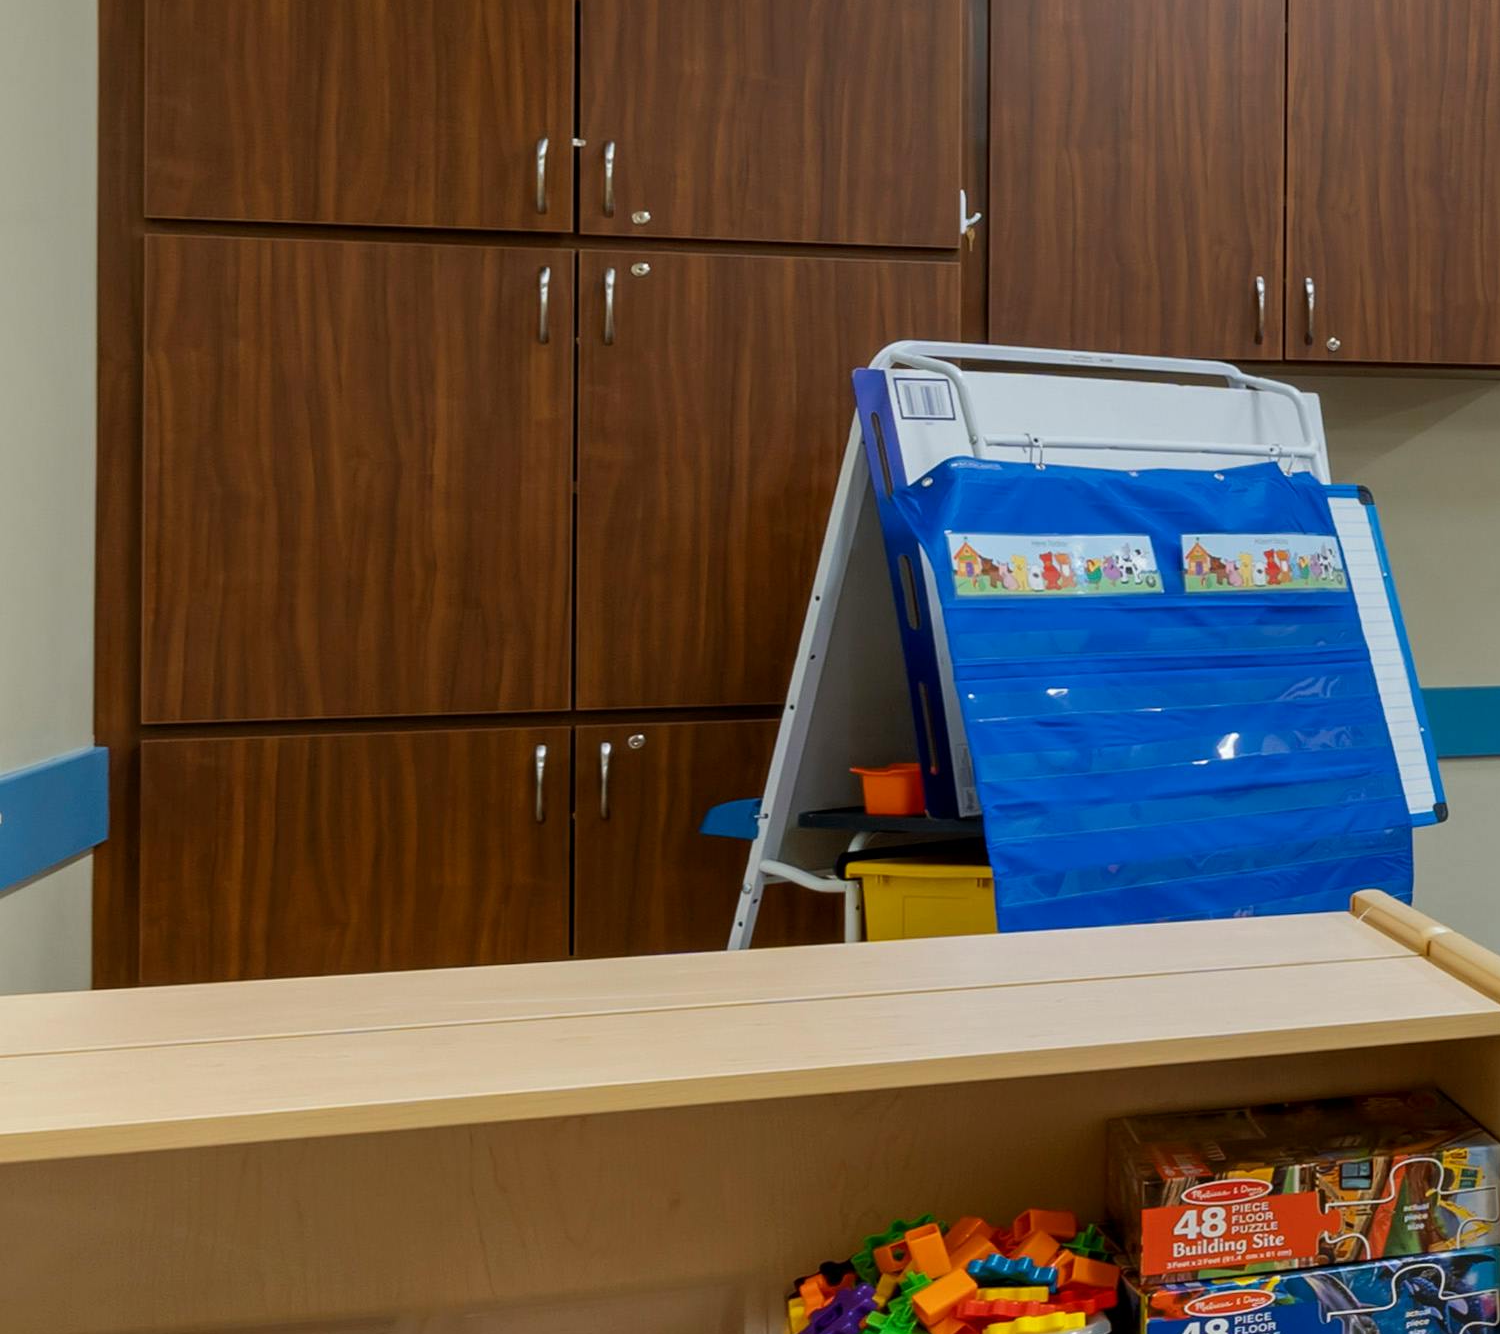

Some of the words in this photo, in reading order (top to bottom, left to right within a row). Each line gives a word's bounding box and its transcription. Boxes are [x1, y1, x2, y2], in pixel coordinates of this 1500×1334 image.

[1232, 1201, 1269, 1213] PIECE
[1173, 1207, 1227, 1240] 48
[1232, 1211, 1274, 1224] FLOOR
[1231, 1221, 1279, 1235] PUZZLE
[1173, 1237, 1247, 1258] Building
[1252, 1233, 1285, 1249] Site
[1234, 1312, 1272, 1325] PIECE
[1234, 1322, 1277, 1334] FLOOR
